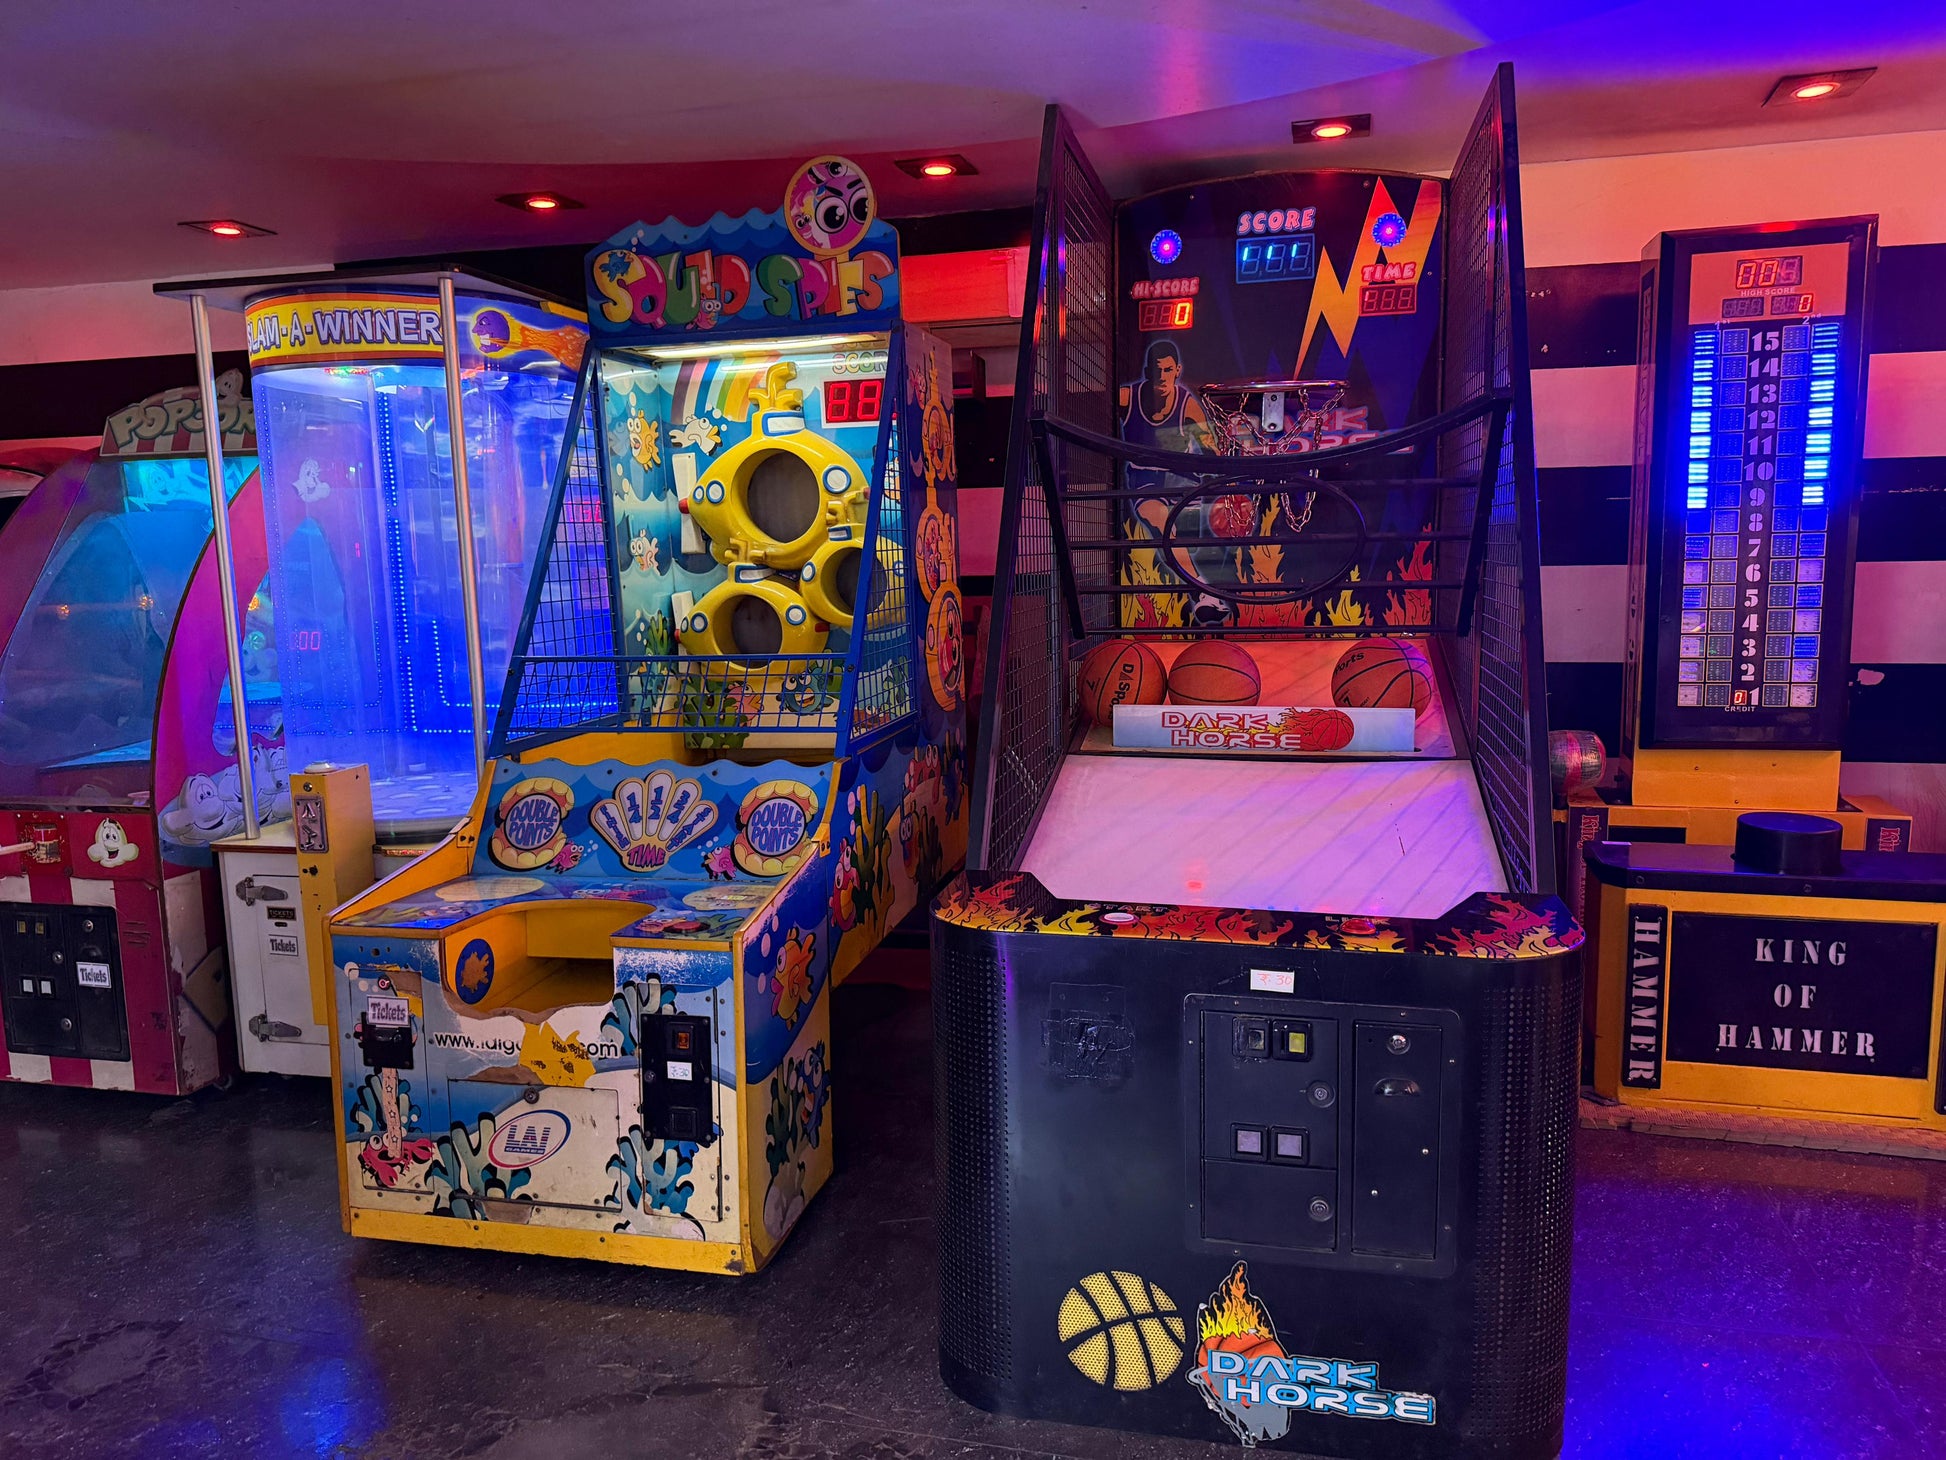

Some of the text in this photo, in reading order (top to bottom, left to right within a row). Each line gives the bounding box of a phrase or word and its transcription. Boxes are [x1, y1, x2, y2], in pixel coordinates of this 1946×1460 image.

[1237, 206, 1316, 234] SCORE
[1361, 262, 1416, 282] TIME
[593, 249, 895, 329] SQUID SPIES
[1765, 287, 1796, 296] SCORE
[247, 307, 444, 355] LAM-A-WINNER
[1751, 331, 1780, 352] 15
[1749, 357, 1780, 378] 14
[827, 381, 882, 422] 88
[1749, 384, 1777, 404] 13
[1748, 410, 1776, 430] 12
[1748, 435, 1773, 456] 11
[1745, 461, 1774, 481] 10
[1749, 487, 1766, 507] 9
[1748, 513, 1763, 532] 8
[1748, 538, 1761, 557] 7
[1745, 563, 1761, 582] 6
[1744, 589, 1759, 608] 5
[1741, 614, 1759, 632] 4
[1741, 638, 1756, 657] 3
[1740, 663, 1755, 681] 2
[1749, 687, 1760, 706] 1
[1161, 711, 1268, 730] DARK
[1171, 729, 1301, 749] HORSE
[510, 799, 559, 823] DOUBLE
[751, 802, 804, 827] DOUBLE
[508, 821, 554, 846] POINTS
[750, 826, 799, 852] POINTS
[627, 843, 667, 869] TIME
[270, 938, 296, 953] Tickets
[1755, 938, 1848, 966] KING
[80, 968, 107, 983] Tickets
[1629, 917, 1661, 1082] HAMMER
[1774, 983, 1816, 1009] OF
[371, 1002, 406, 1021] Tickets
[1718, 1024, 1876, 1057] HAMMER
[505, 1125, 551, 1147] LAI
[505, 1147, 545, 1155] GAMES
[1208, 1350, 1376, 1389] DARK
[1224, 1378, 1433, 1423] HORSE
